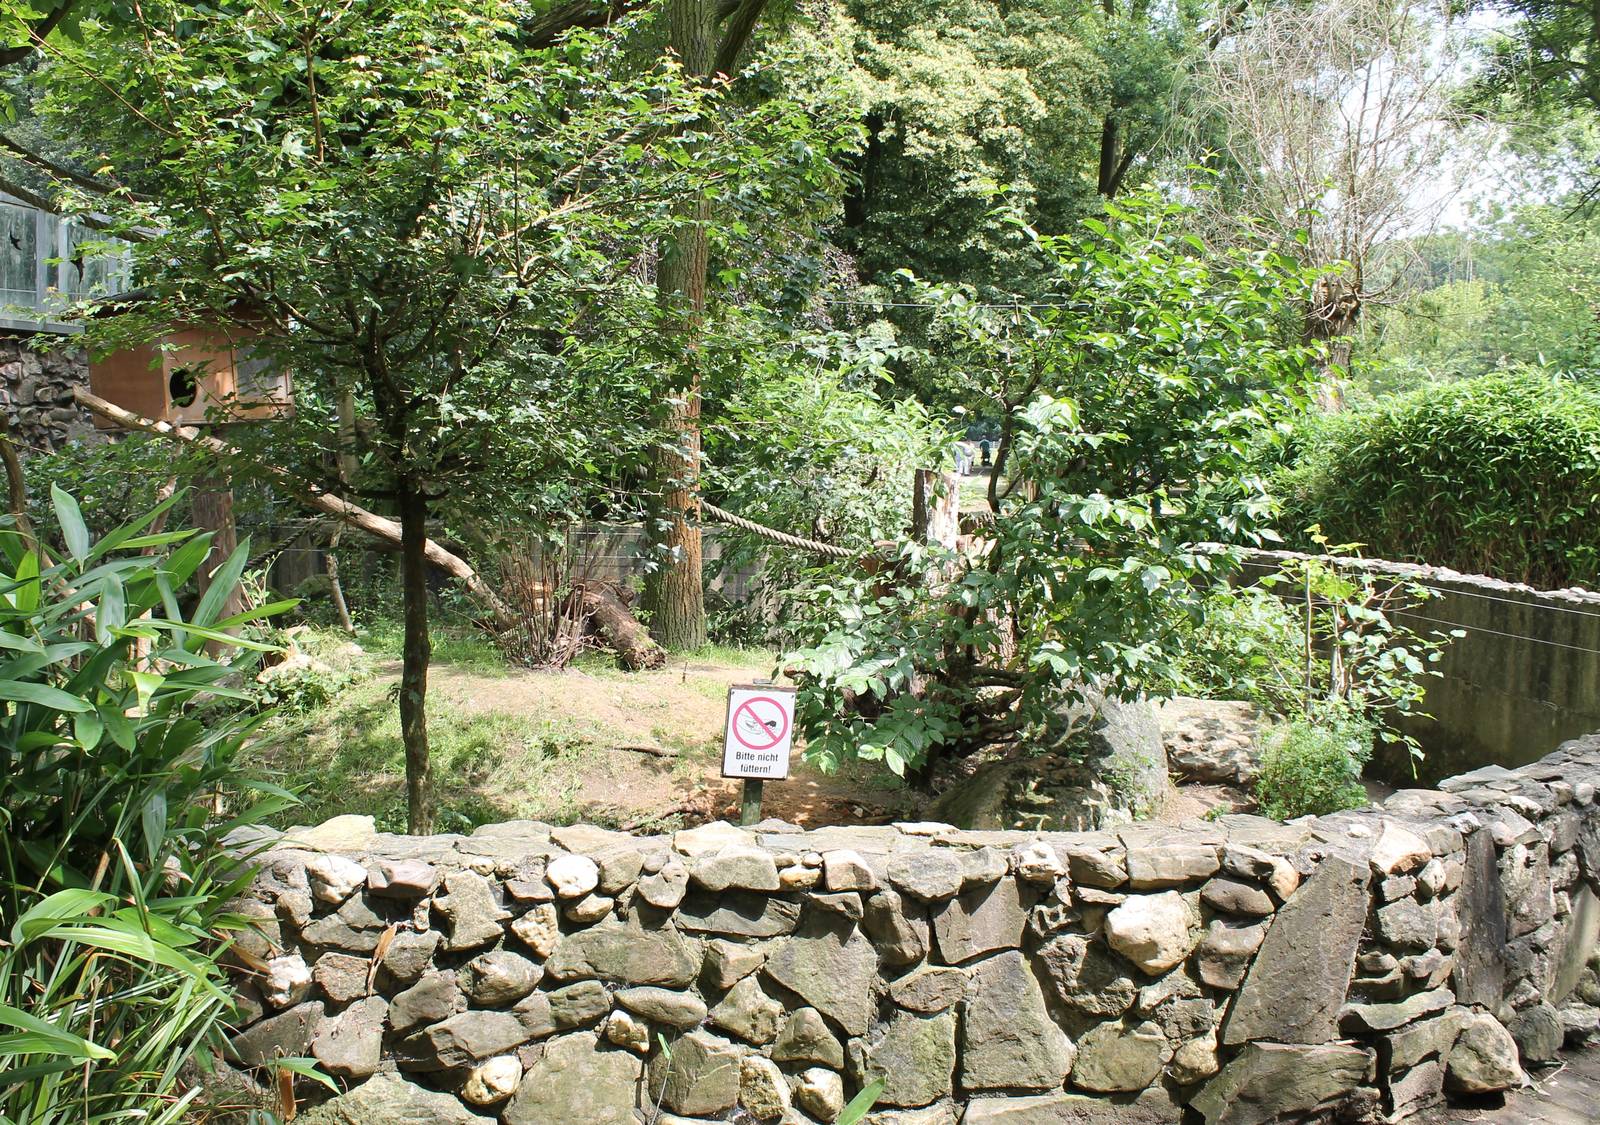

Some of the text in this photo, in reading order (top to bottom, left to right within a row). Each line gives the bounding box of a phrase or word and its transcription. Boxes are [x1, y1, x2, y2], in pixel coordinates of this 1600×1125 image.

[736, 751, 779, 762] Bitte nicht
[740, 763, 771, 773] füttern!
